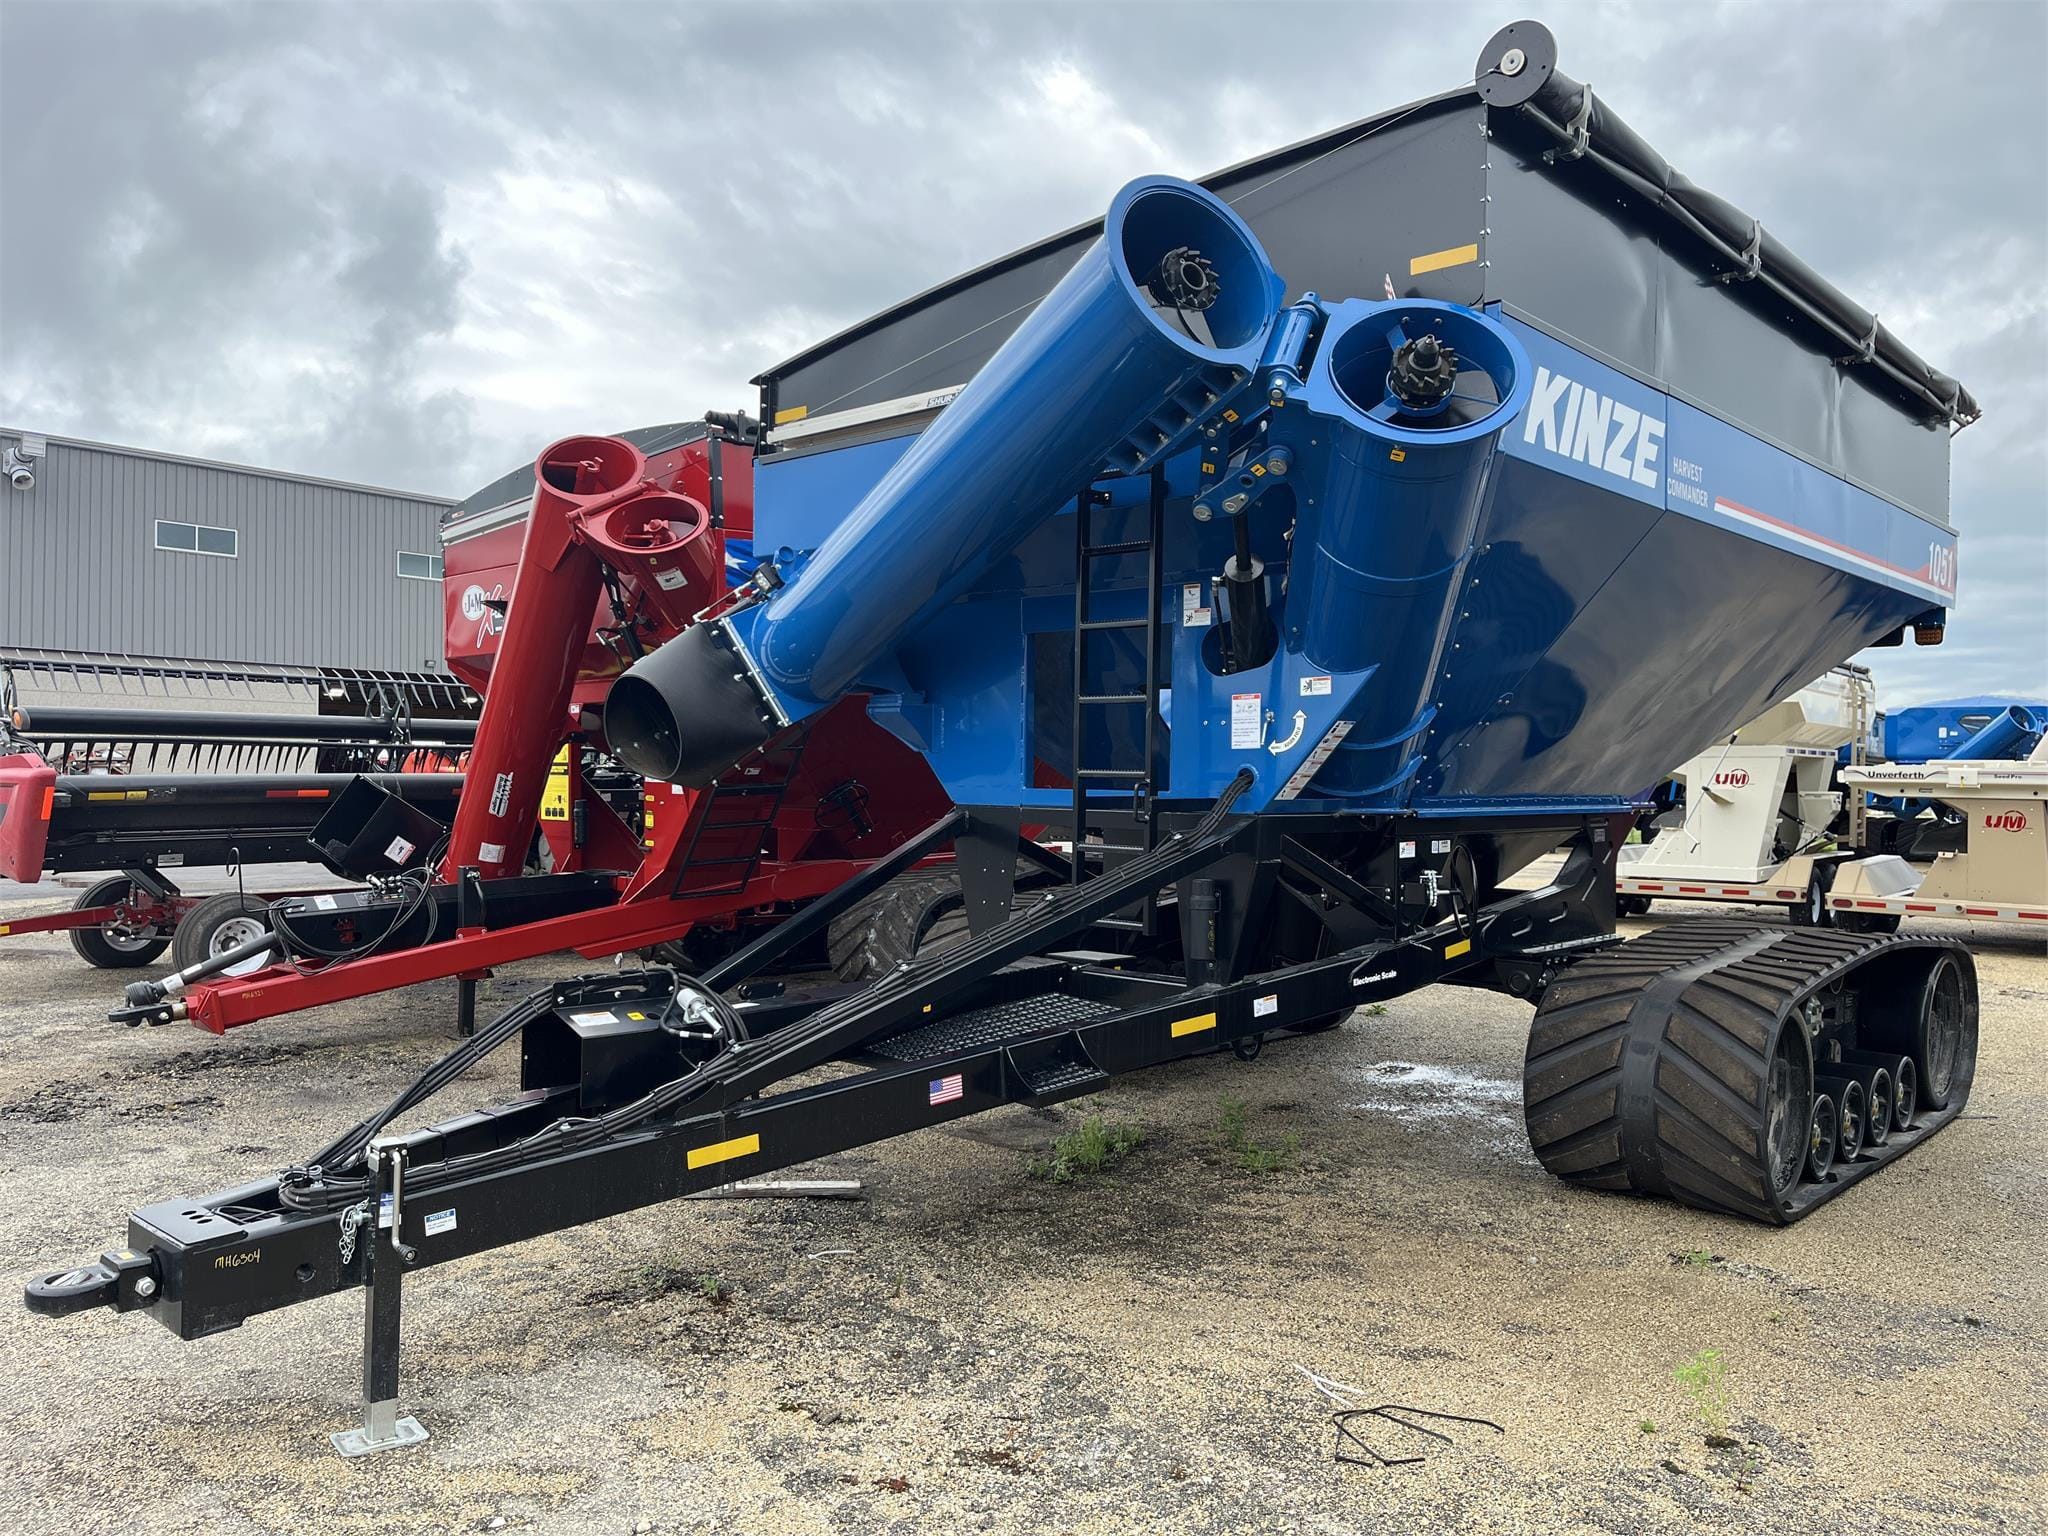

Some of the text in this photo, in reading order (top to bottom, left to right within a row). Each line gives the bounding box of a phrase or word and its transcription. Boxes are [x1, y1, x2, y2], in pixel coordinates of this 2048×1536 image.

[1523, 366, 1666, 489] KINZE
[1673, 456, 1703, 484] HARVEST
[1667, 478, 1709, 508] COMMANDER
[1928, 541, 1953, 588] 1051
[1868, 771, 1925, 779] Unverferth
[1353, 970, 1397, 986] Electronic Scale
[214, 1248, 260, 1269] MH6304
